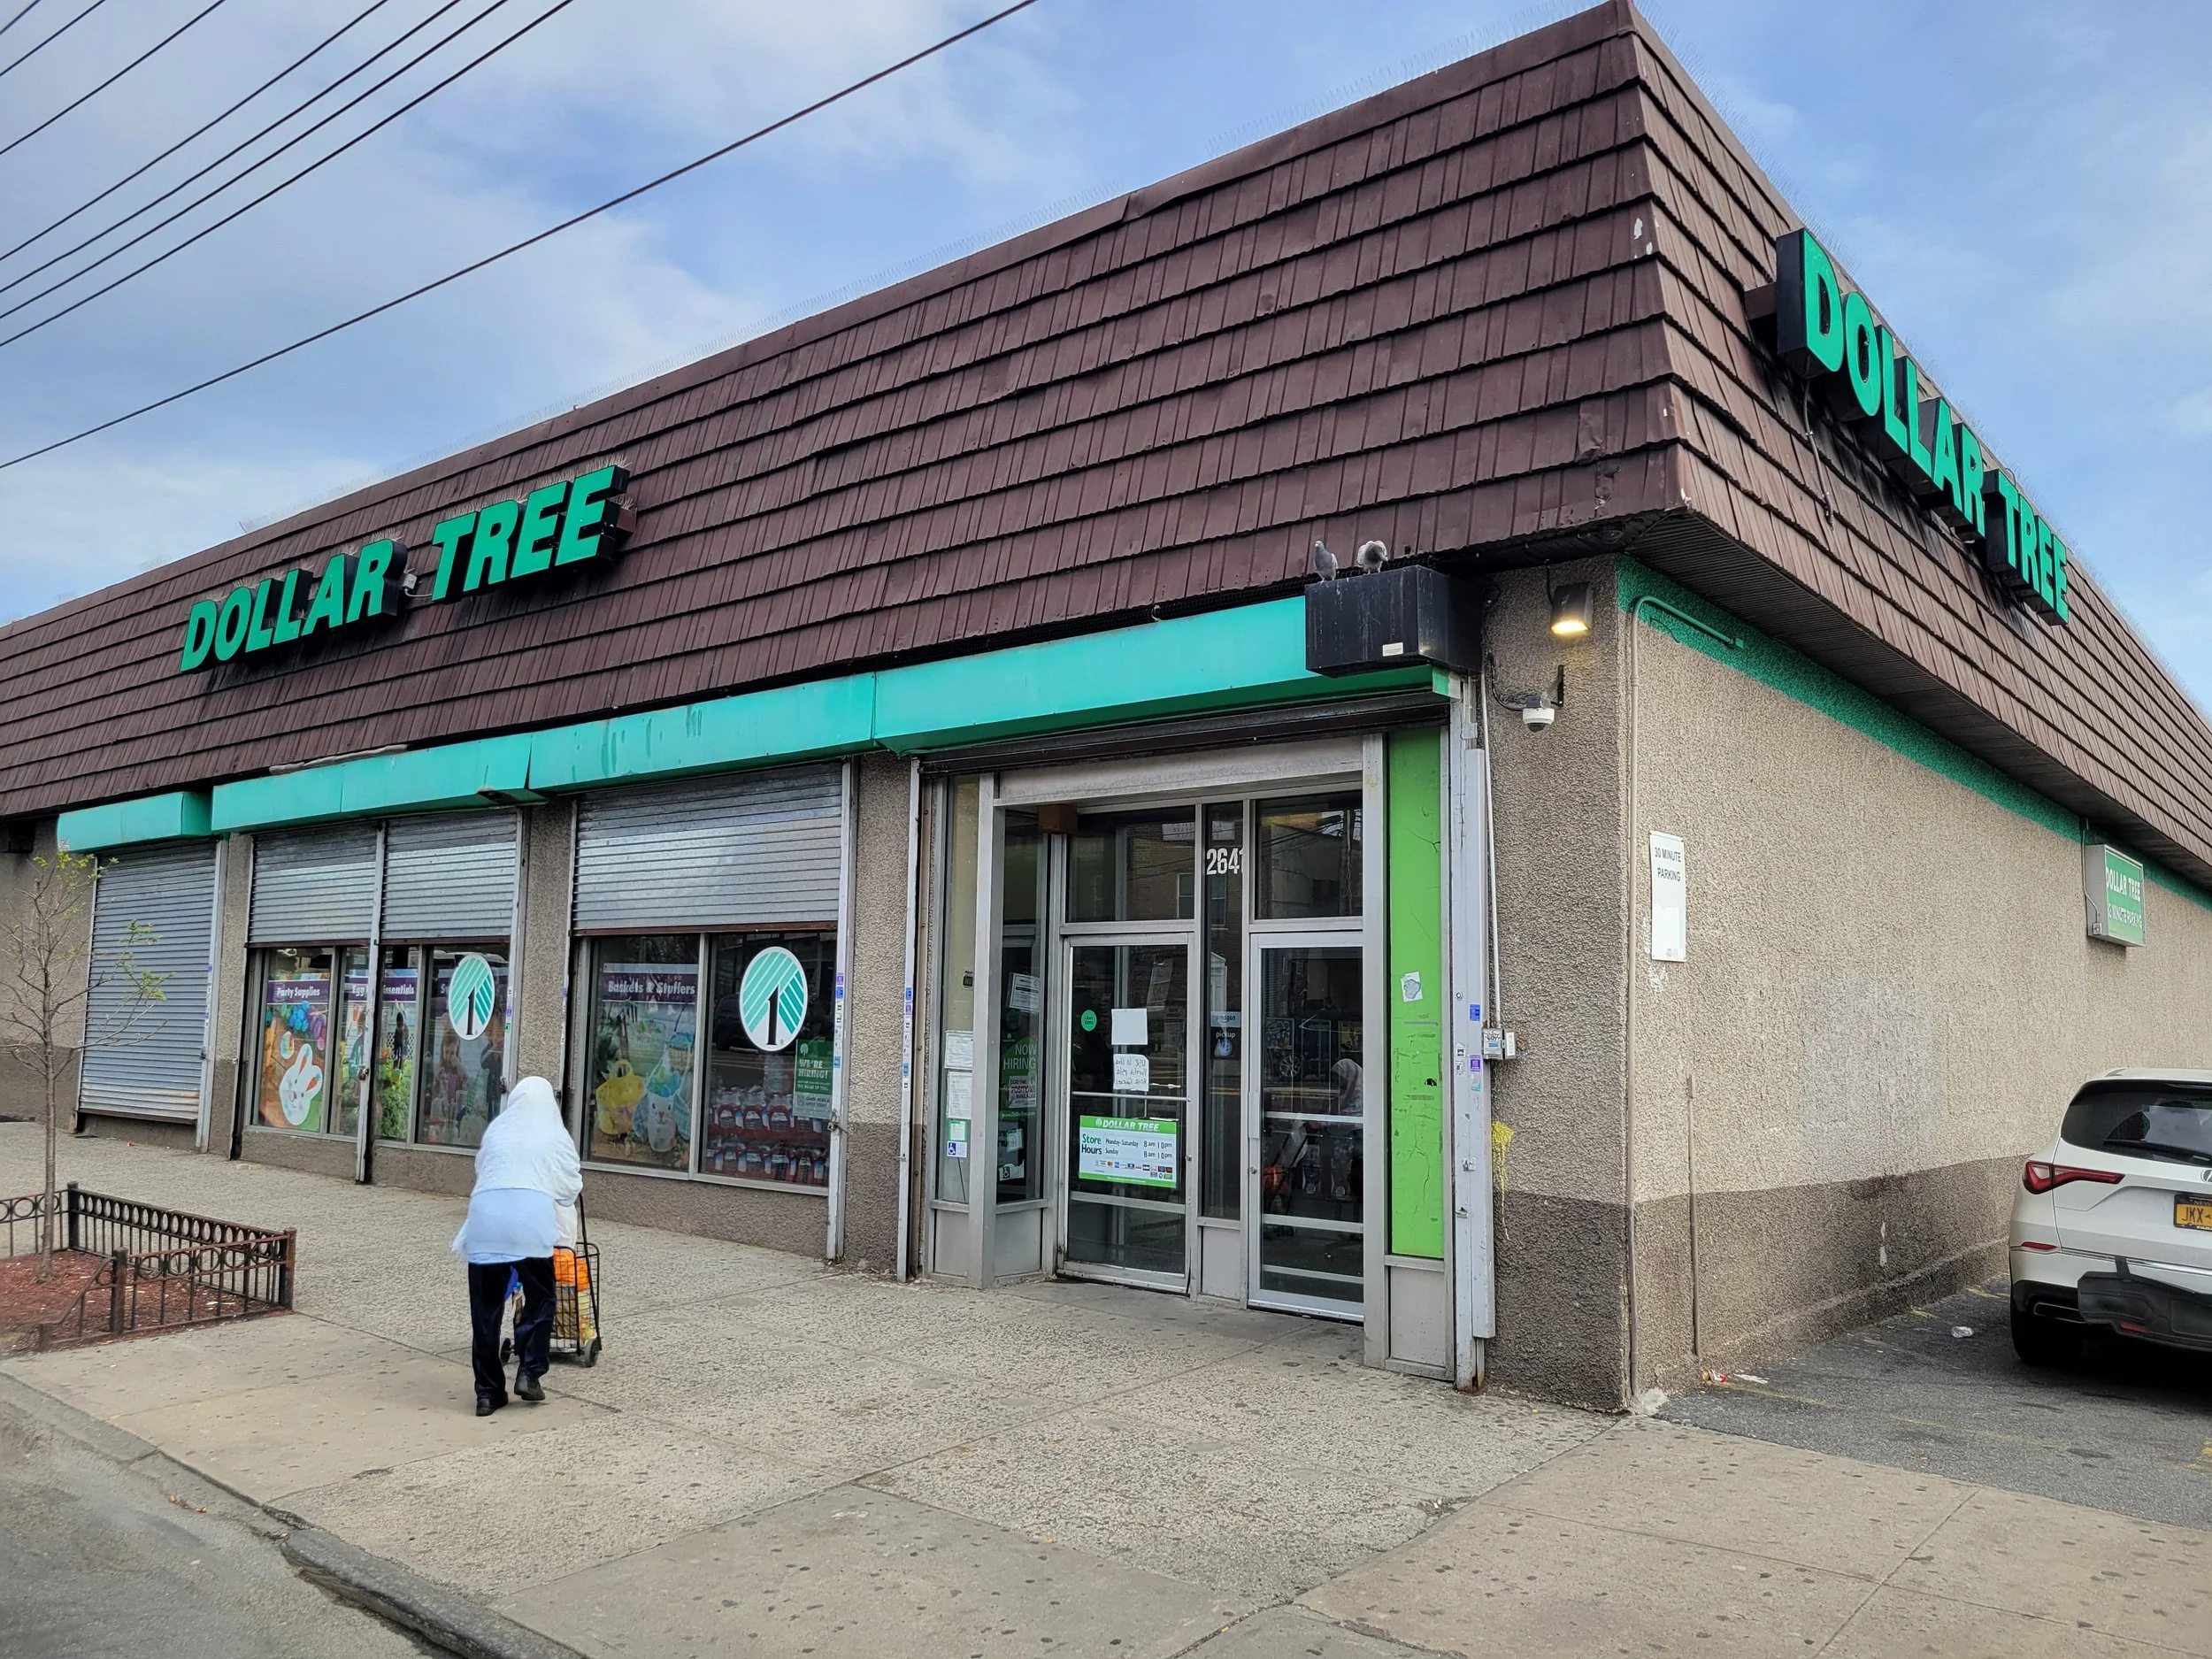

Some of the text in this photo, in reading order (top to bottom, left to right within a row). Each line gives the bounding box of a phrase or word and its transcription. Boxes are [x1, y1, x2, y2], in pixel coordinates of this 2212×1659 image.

[1803, 228, 2070, 625] DOLLAR TREE
[180, 465, 617, 672] DOLLAR TREE
[1655, 847, 1682, 863] 30 MINUTE
[1657, 867, 1681, 882] PARKING
[2106, 867, 2139, 902] DOLLAR TREE
[276, 986, 320, 999] Party Supplies
[608, 979, 643, 994] Baskets
[657, 981, 695, 995] Stuffers
[1216, 1031, 1236, 1040] pickup
[1015, 1044, 1037, 1056] NOW
[1003, 1057, 1037, 1070] HIRING
[798, 1069, 828, 1079] HIRING!
[1102, 1120, 1160, 1132] DOLLAR TREE
[1082, 1133, 1102, 1145] Store
[1105, 1138, 1139, 1148] Monday-Saturday
[1081, 1144, 1102, 1155] Hours
